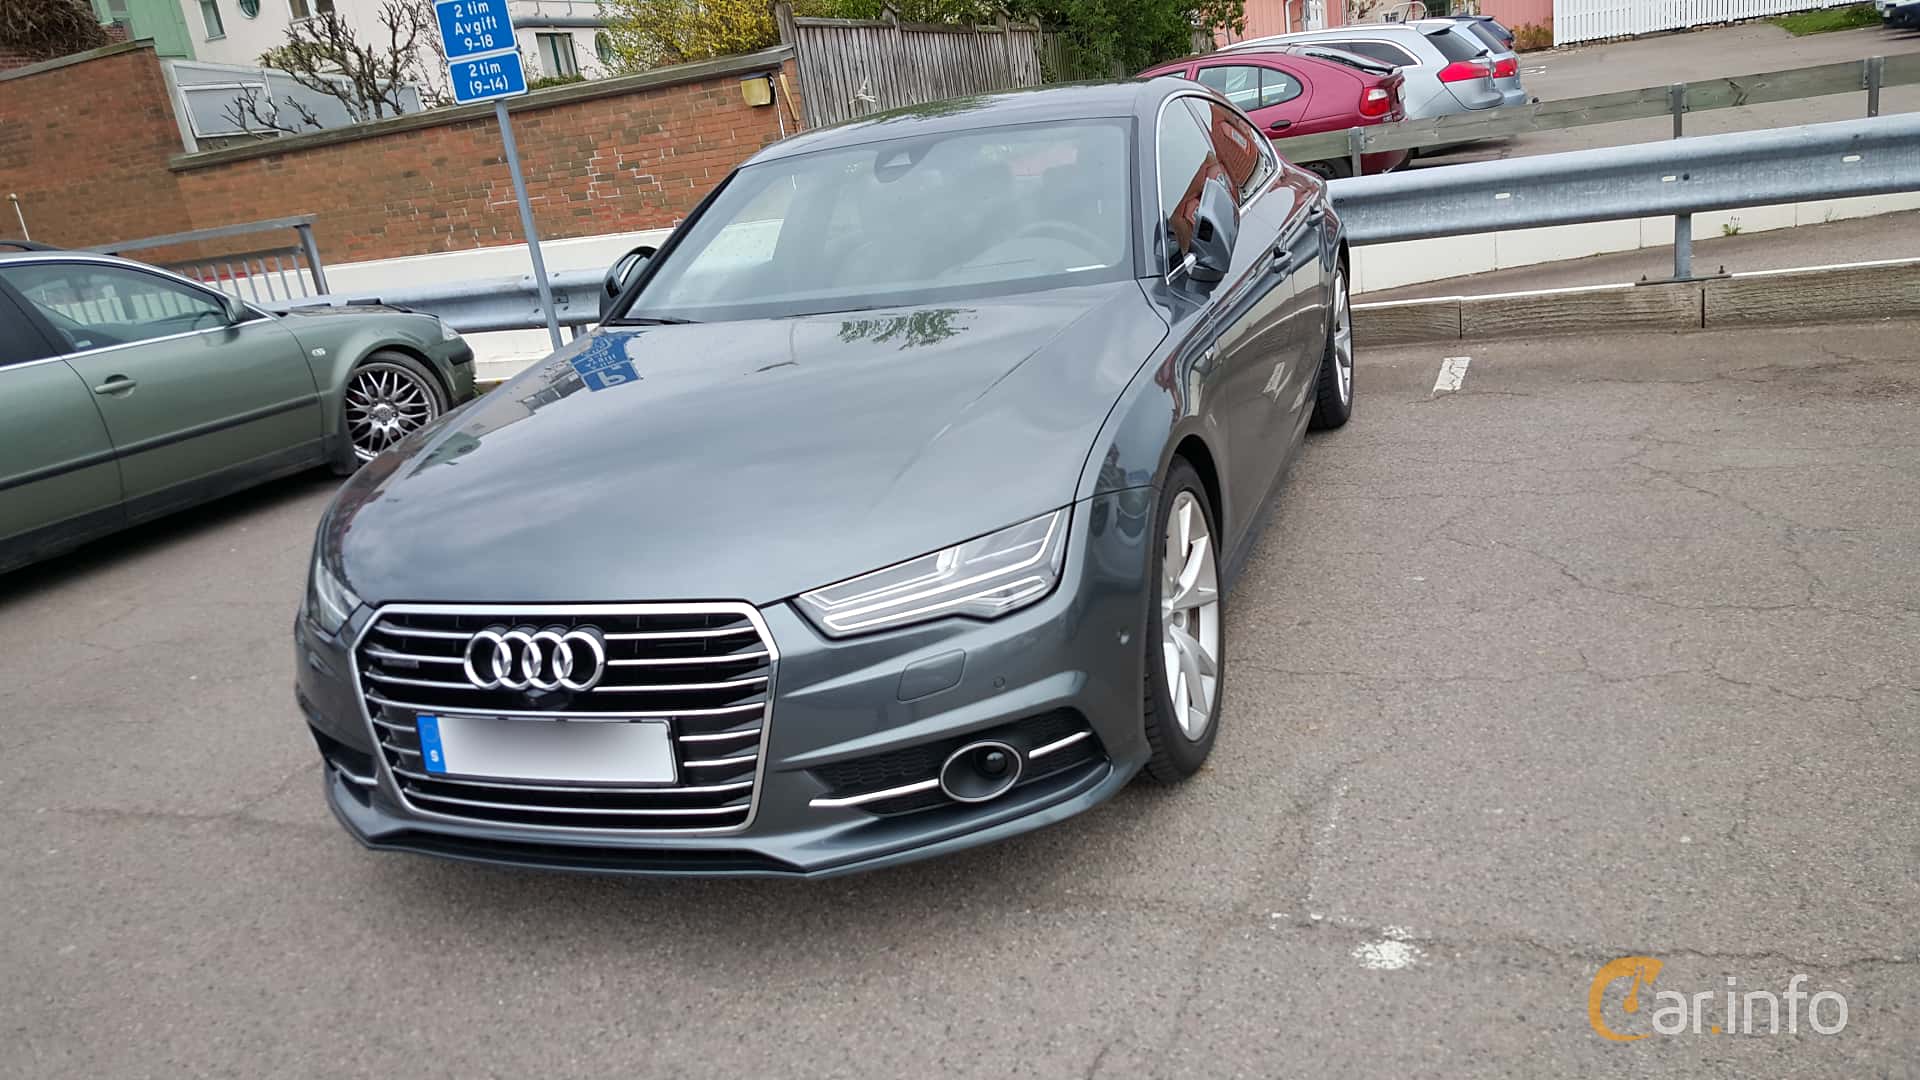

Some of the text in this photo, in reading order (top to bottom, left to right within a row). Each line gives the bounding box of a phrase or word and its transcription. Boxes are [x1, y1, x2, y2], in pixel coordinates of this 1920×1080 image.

[454, 1, 489, 18] 2 tim
[455, 16, 497, 35] Avgift
[464, 34, 494, 51] 9-18
[468, 61, 501, 77] 2 tim
[469, 75, 509, 96] (9-14)
